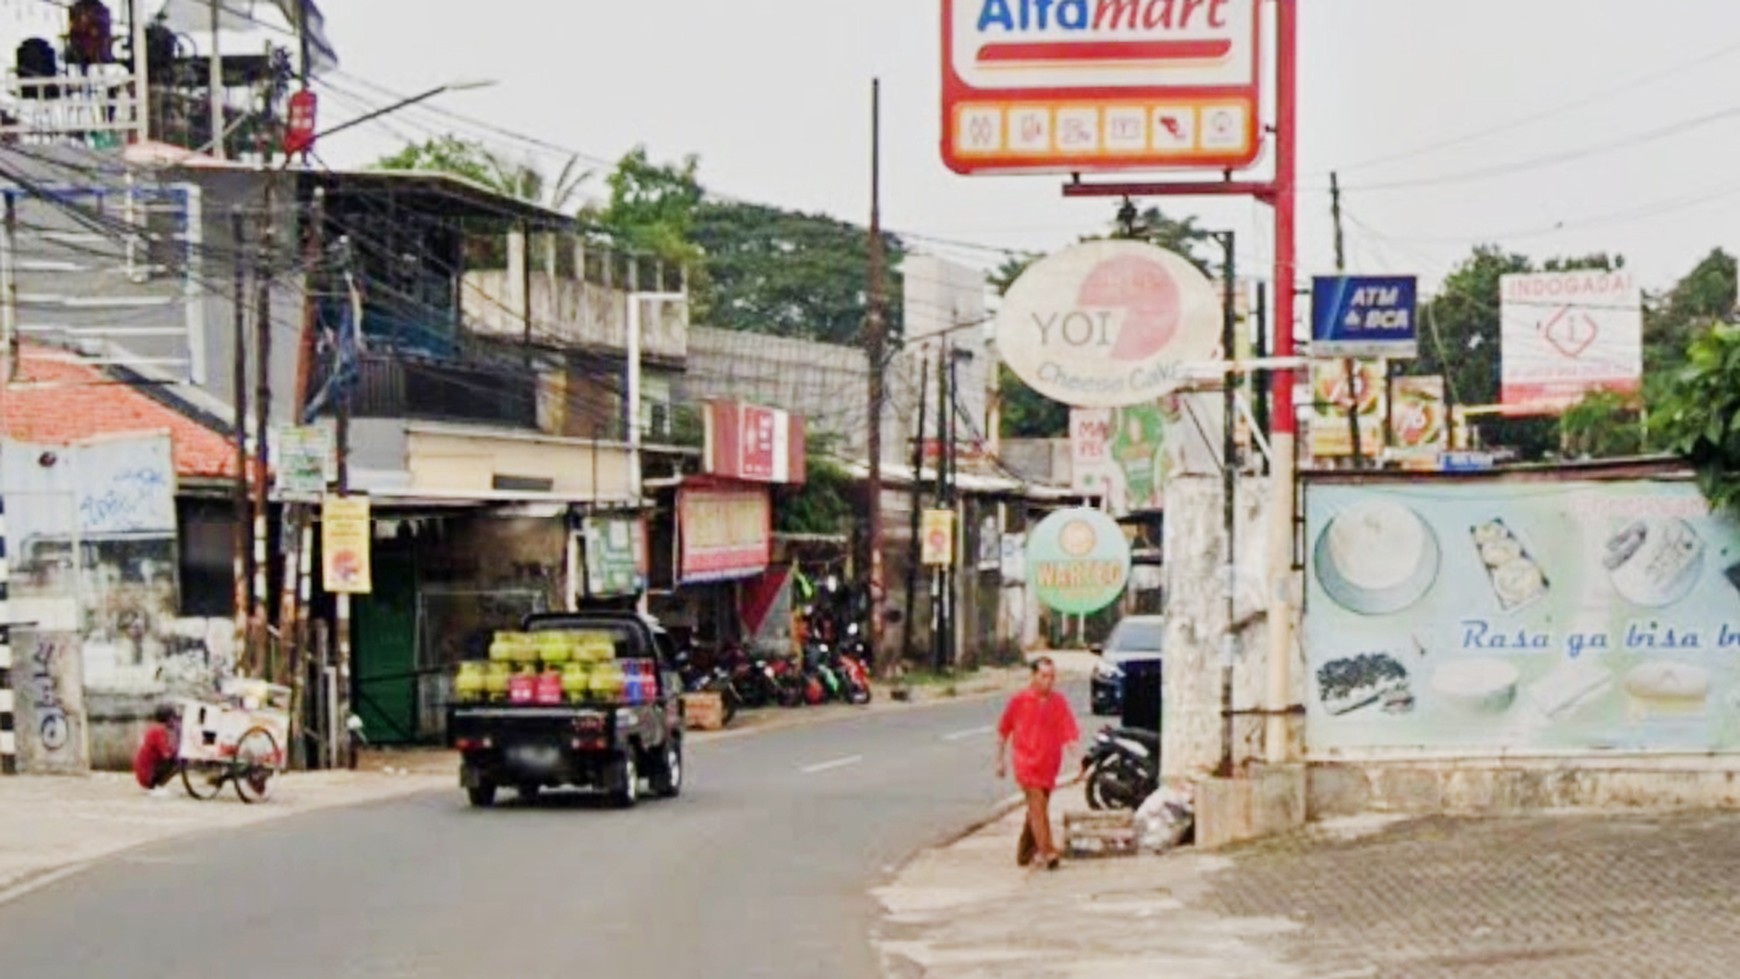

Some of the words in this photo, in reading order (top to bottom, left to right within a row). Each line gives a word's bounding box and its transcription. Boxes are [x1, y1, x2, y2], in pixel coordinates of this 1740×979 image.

[1351, 286, 1399, 306] ATM
[1509, 274, 1633, 297] INDOGADAI
[1031, 311, 1112, 346] YOI
[1364, 309, 1408, 329] BCA
[1461, 620, 1551, 649] Rasa
[1567, 633, 1608, 658] ga
[1625, 620, 1700, 649] bisa
